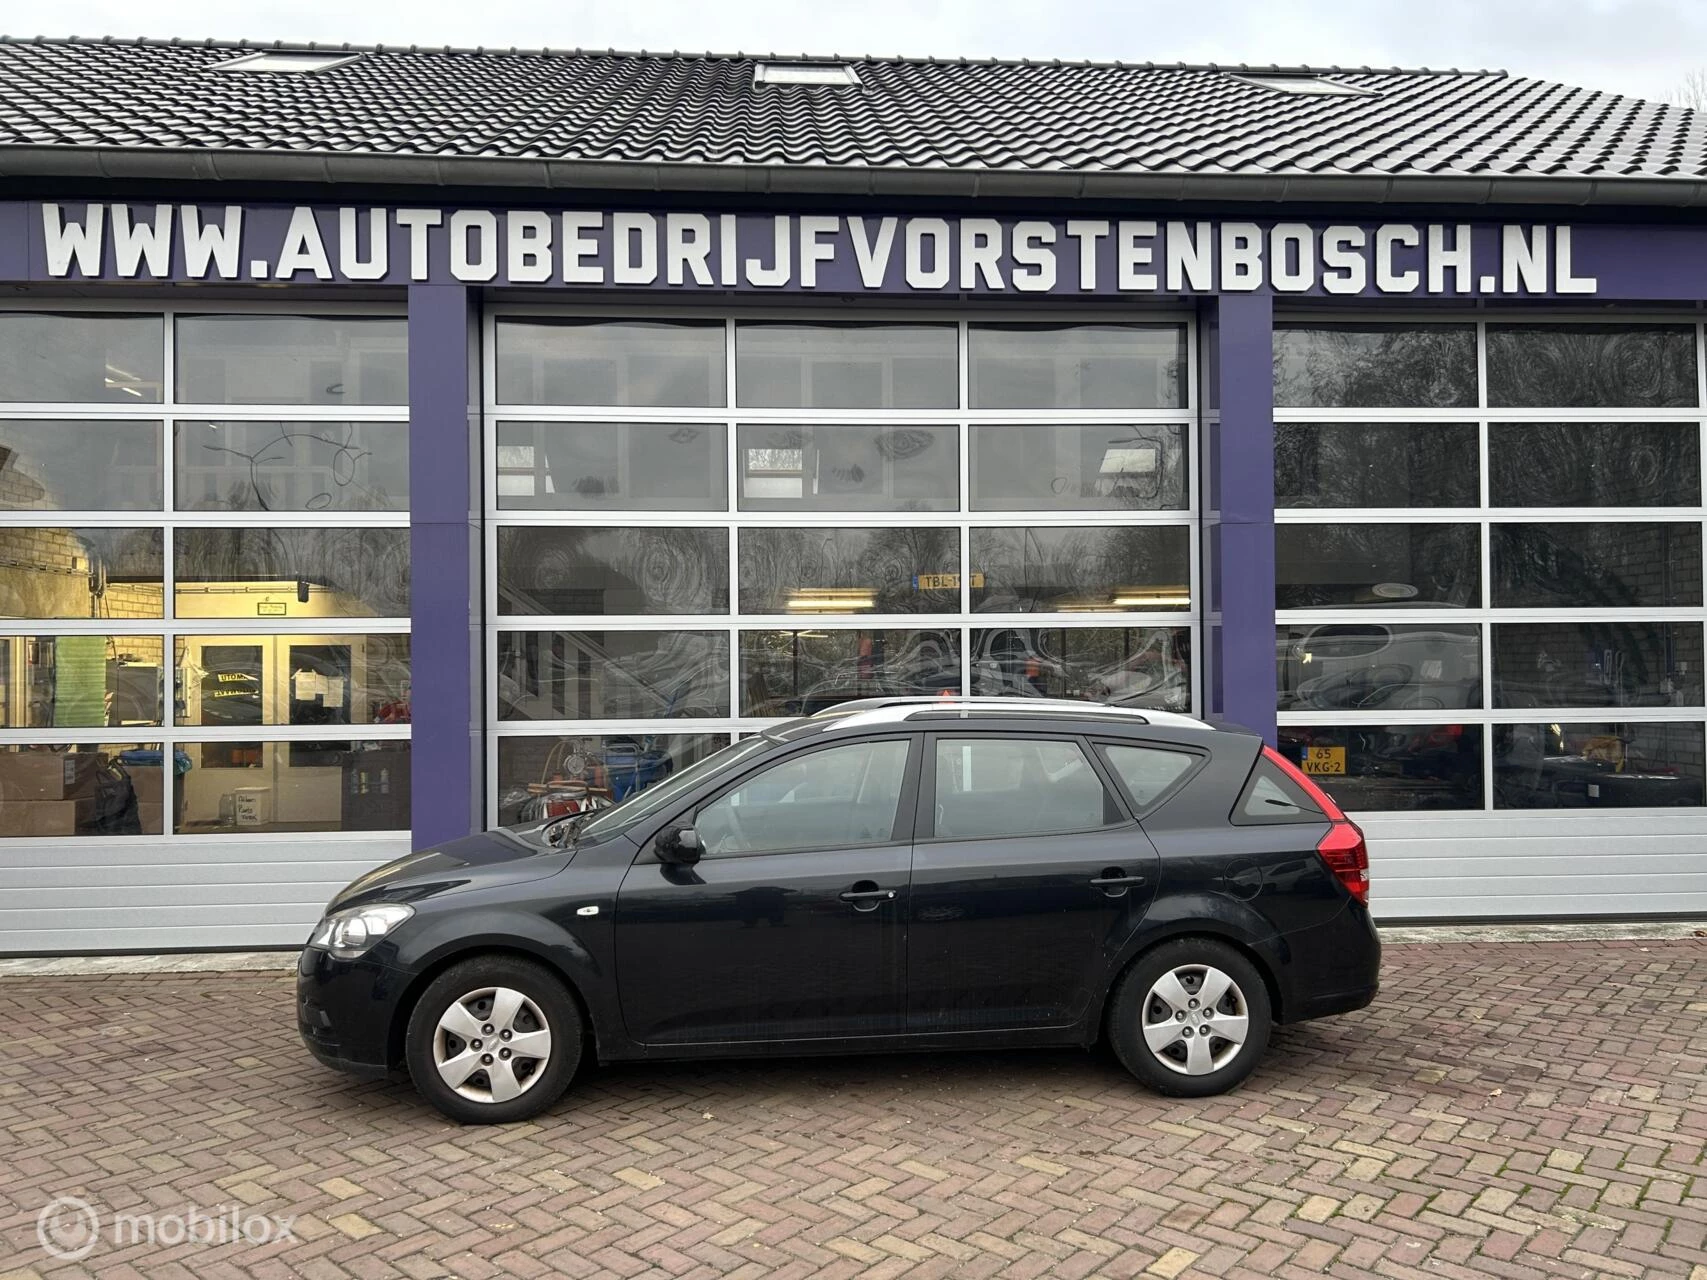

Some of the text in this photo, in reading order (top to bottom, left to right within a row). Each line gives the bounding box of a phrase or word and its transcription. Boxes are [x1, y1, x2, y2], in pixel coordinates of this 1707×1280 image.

[42, 203, 1597, 293] WWW.AUTOBEDRIJFVORSTENBOSCH.NL
[1316, 748, 1332, 759] 65
[1306, 762, 1341, 773] VKG-2
